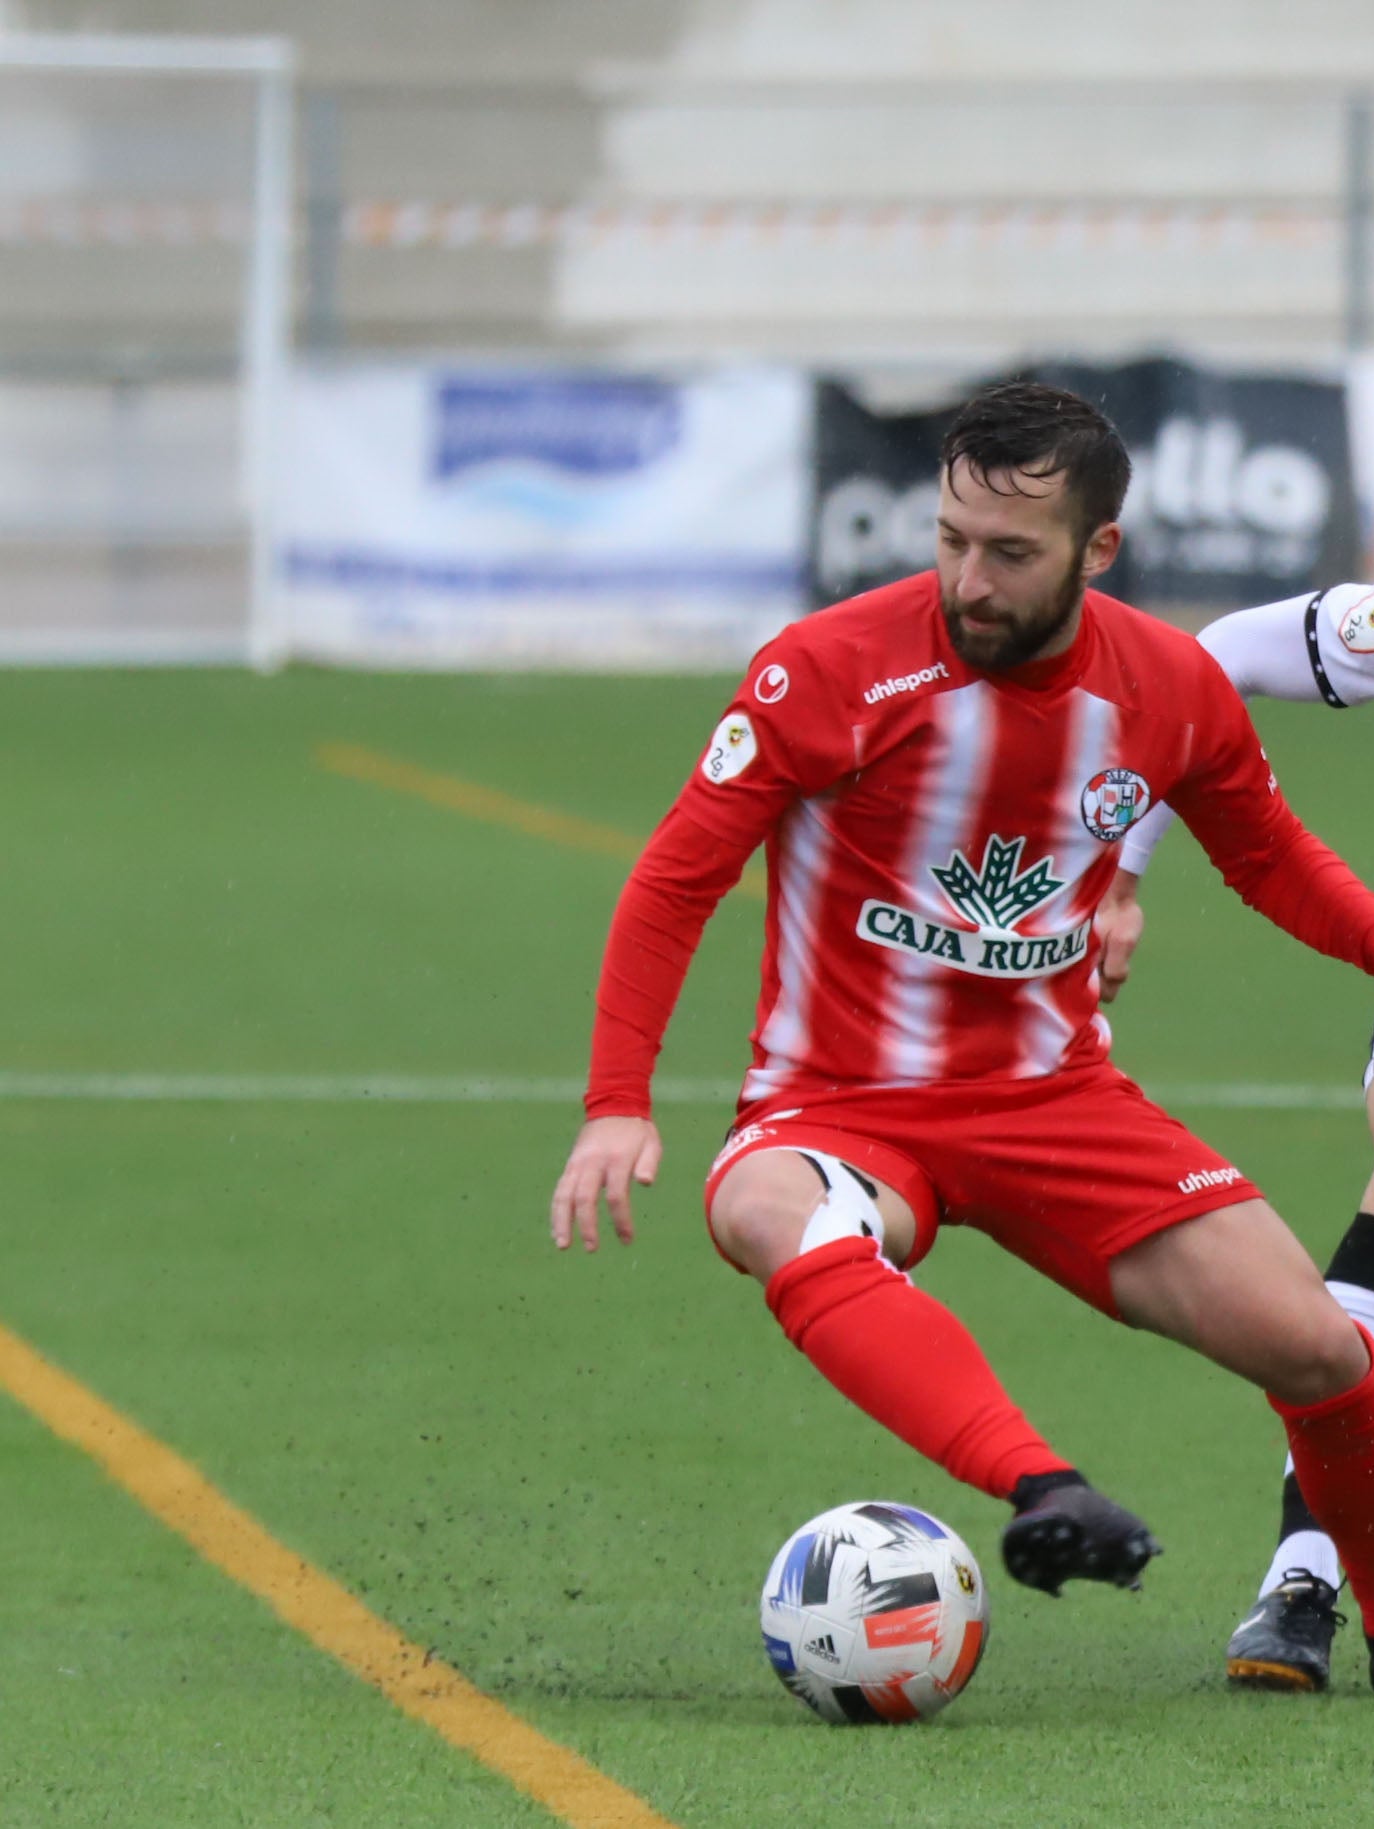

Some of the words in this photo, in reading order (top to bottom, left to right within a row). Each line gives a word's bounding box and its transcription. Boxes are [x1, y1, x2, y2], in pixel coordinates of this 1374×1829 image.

[863, 661, 950, 705] uhlsport
[865, 906, 966, 963] CAJA
[978, 926, 1086, 971] RURAL
